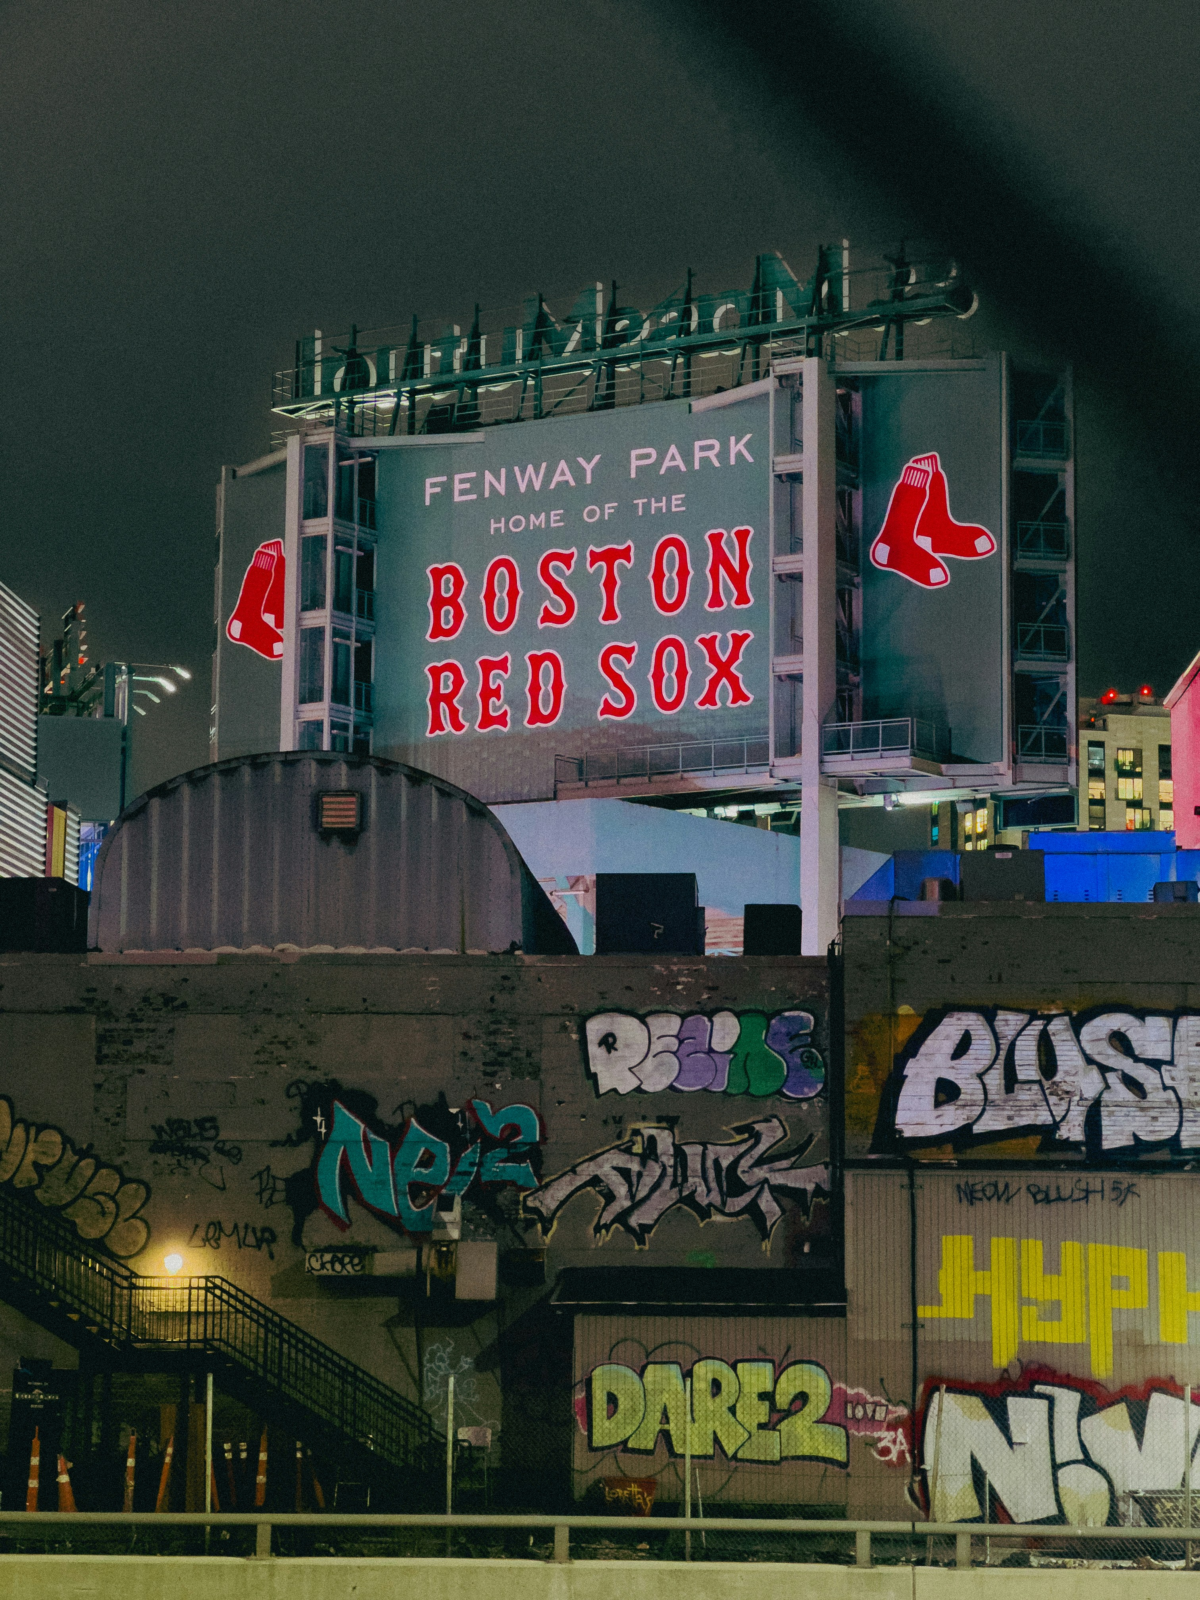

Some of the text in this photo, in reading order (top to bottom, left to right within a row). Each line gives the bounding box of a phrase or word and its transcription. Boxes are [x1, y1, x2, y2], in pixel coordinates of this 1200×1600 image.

[424, 433, 755, 506] FENWAY PARK
[489, 494, 687, 536] HOME OF THE
[425, 525, 755, 643] BOSTON
[424, 629, 755, 737] RED SOX
[1026, 1177, 1105, 1205] BLUSH
[585, 1356, 850, 1469] DARE2
